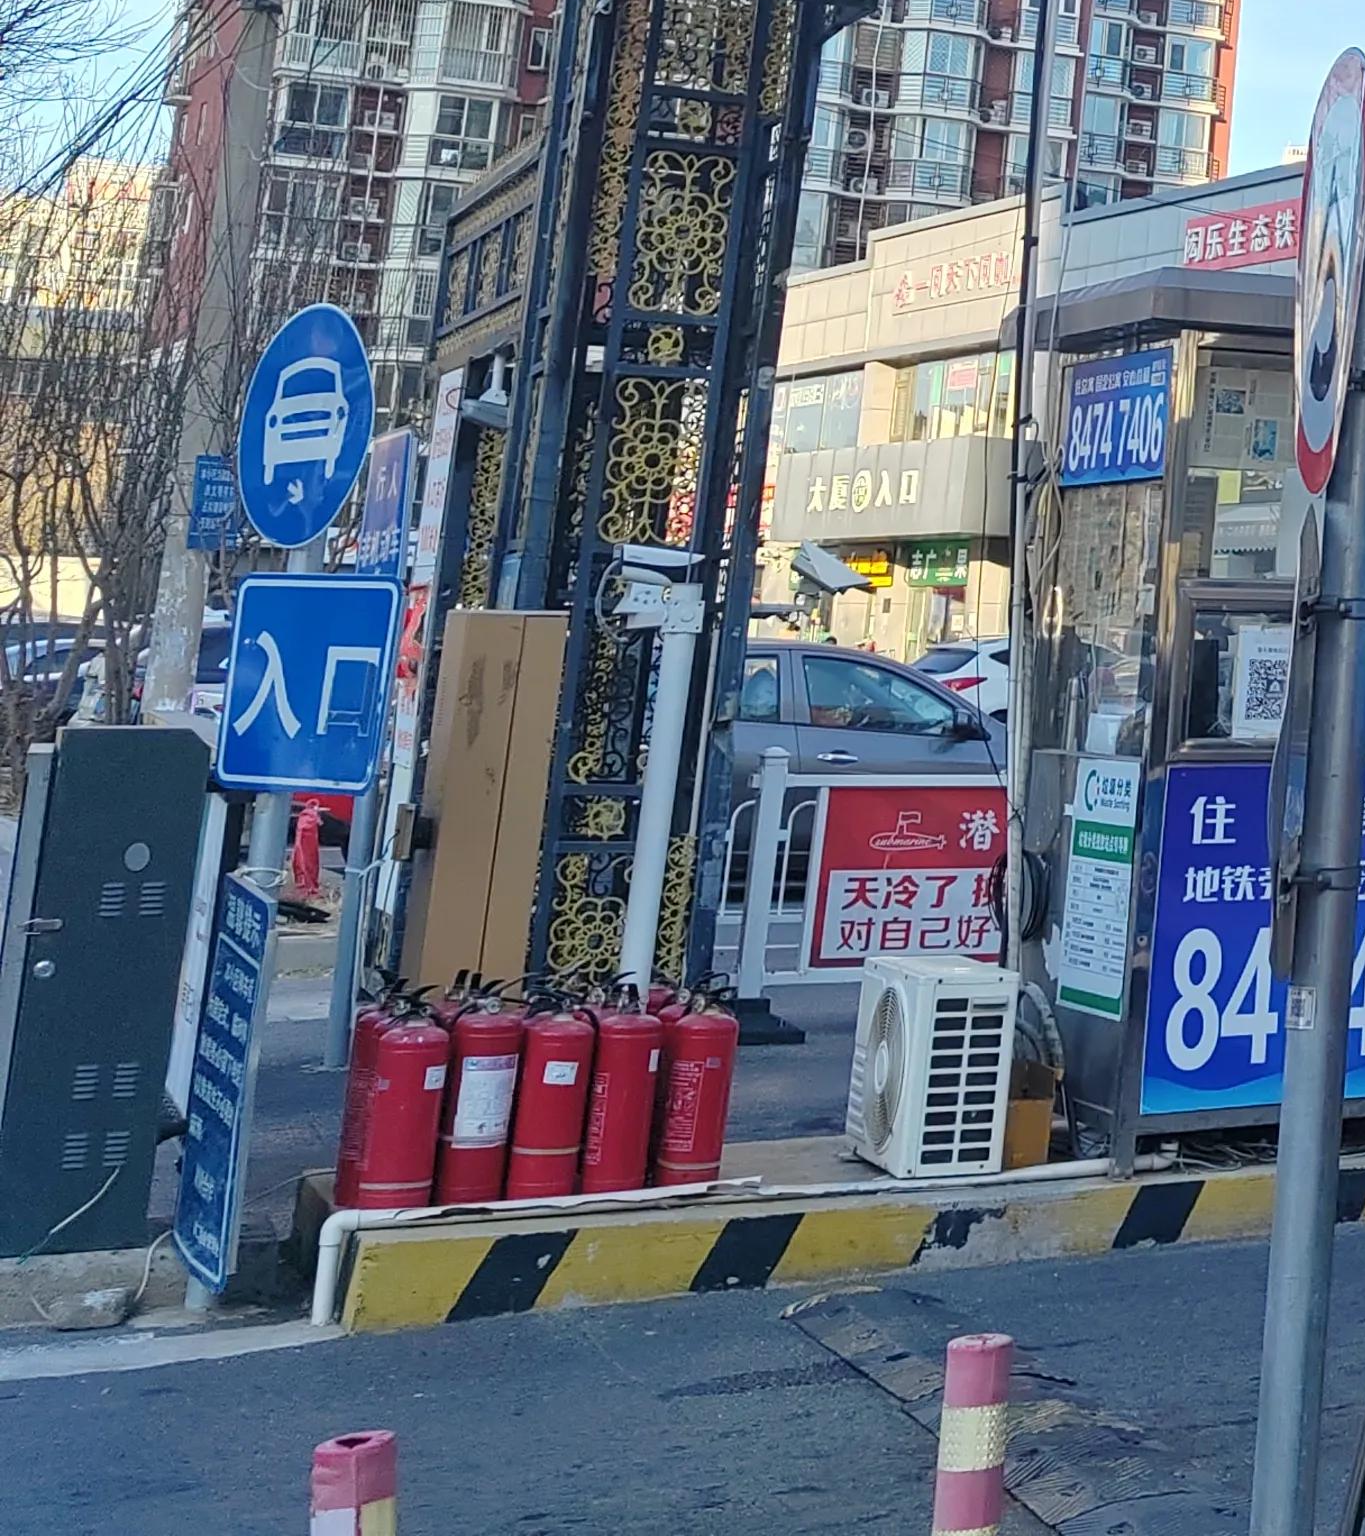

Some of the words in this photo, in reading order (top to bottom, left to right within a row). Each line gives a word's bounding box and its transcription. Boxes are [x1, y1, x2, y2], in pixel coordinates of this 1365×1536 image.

[1068, 401, 1114, 472] 8474
[1117, 392, 1164, 466] 7406
[874, 836, 932, 848] submarine
[959, 810, 1000, 852] 潜
[841, 875, 959, 911] 天冷了
[836, 916, 993, 952] 对自己好
